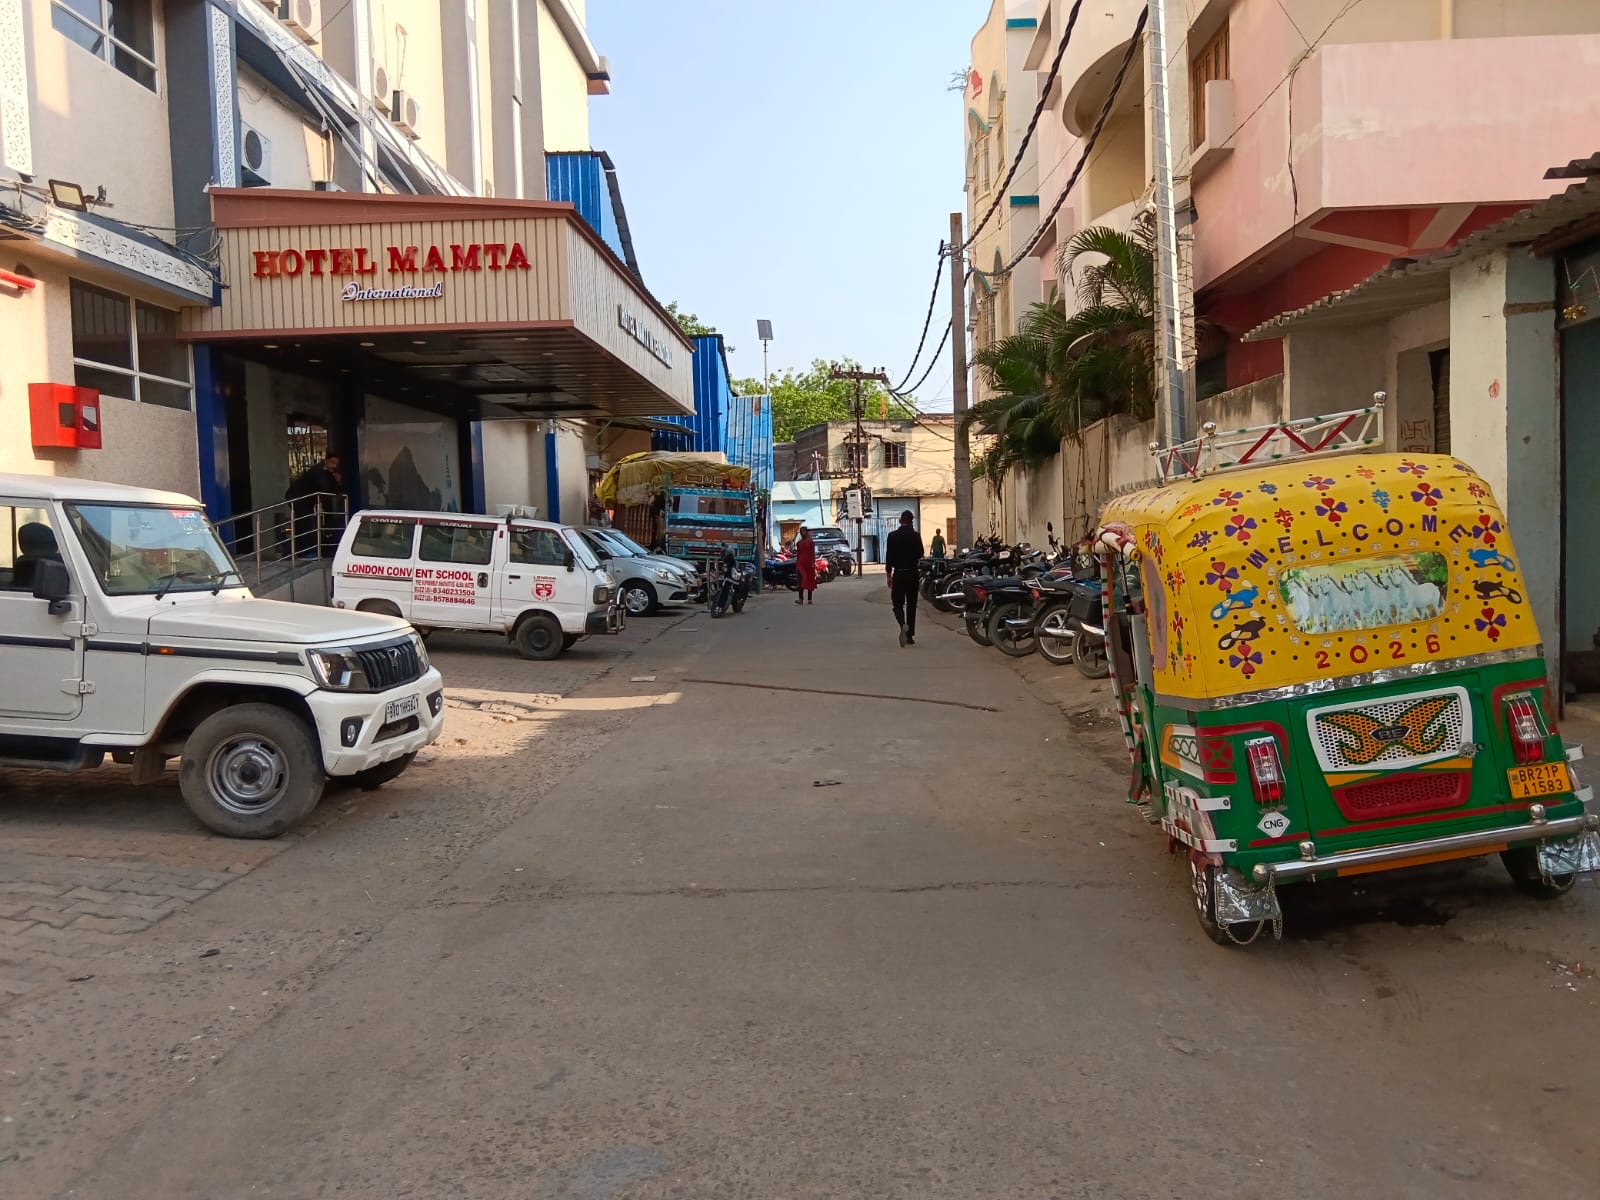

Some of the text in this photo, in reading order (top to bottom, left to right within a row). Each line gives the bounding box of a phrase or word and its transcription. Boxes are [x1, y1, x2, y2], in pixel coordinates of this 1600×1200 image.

[253, 242, 531, 277] HOTEL MAMTA
[342, 281, 441, 301] International
[347, 563, 385, 575] LONDON
[436, 570, 474, 581] SCHOOL
[1314, 634, 1441, 669] 2026
[1519, 765, 1558, 782] BR21P
[1523, 779, 1563, 796] A1583
[1263, 818, 1284, 830] CNG
